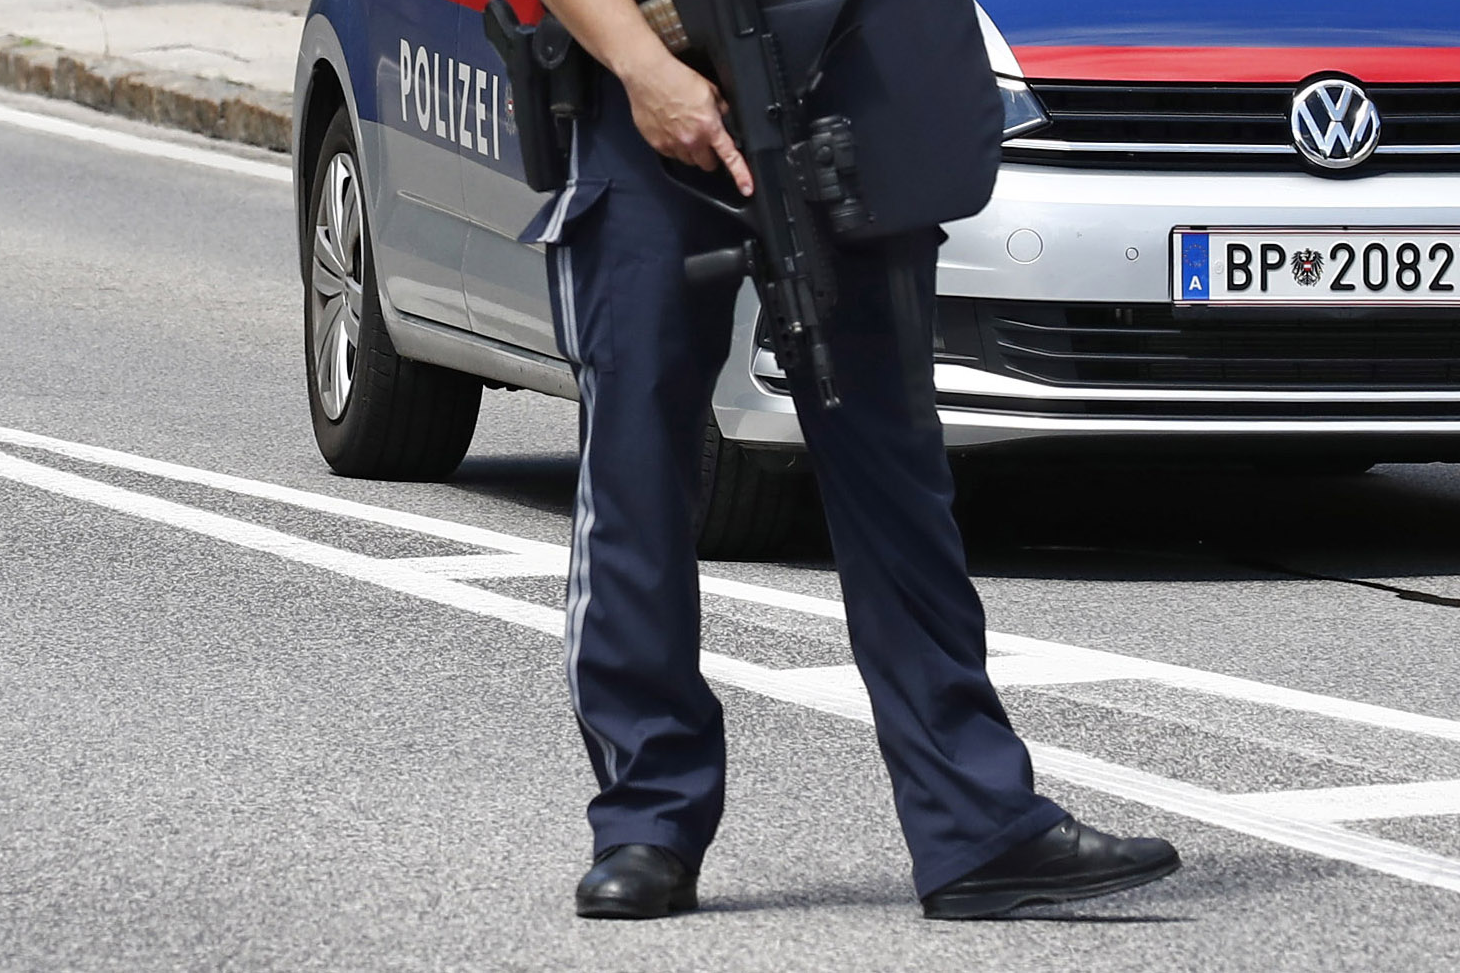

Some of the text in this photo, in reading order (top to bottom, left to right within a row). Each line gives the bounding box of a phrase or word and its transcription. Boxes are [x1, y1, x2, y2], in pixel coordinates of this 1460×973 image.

[400, 38, 500, 161] POLIZEI
[1188, 275, 1203, 291] A
[1227, 242, 1454, 292] BP 2082
